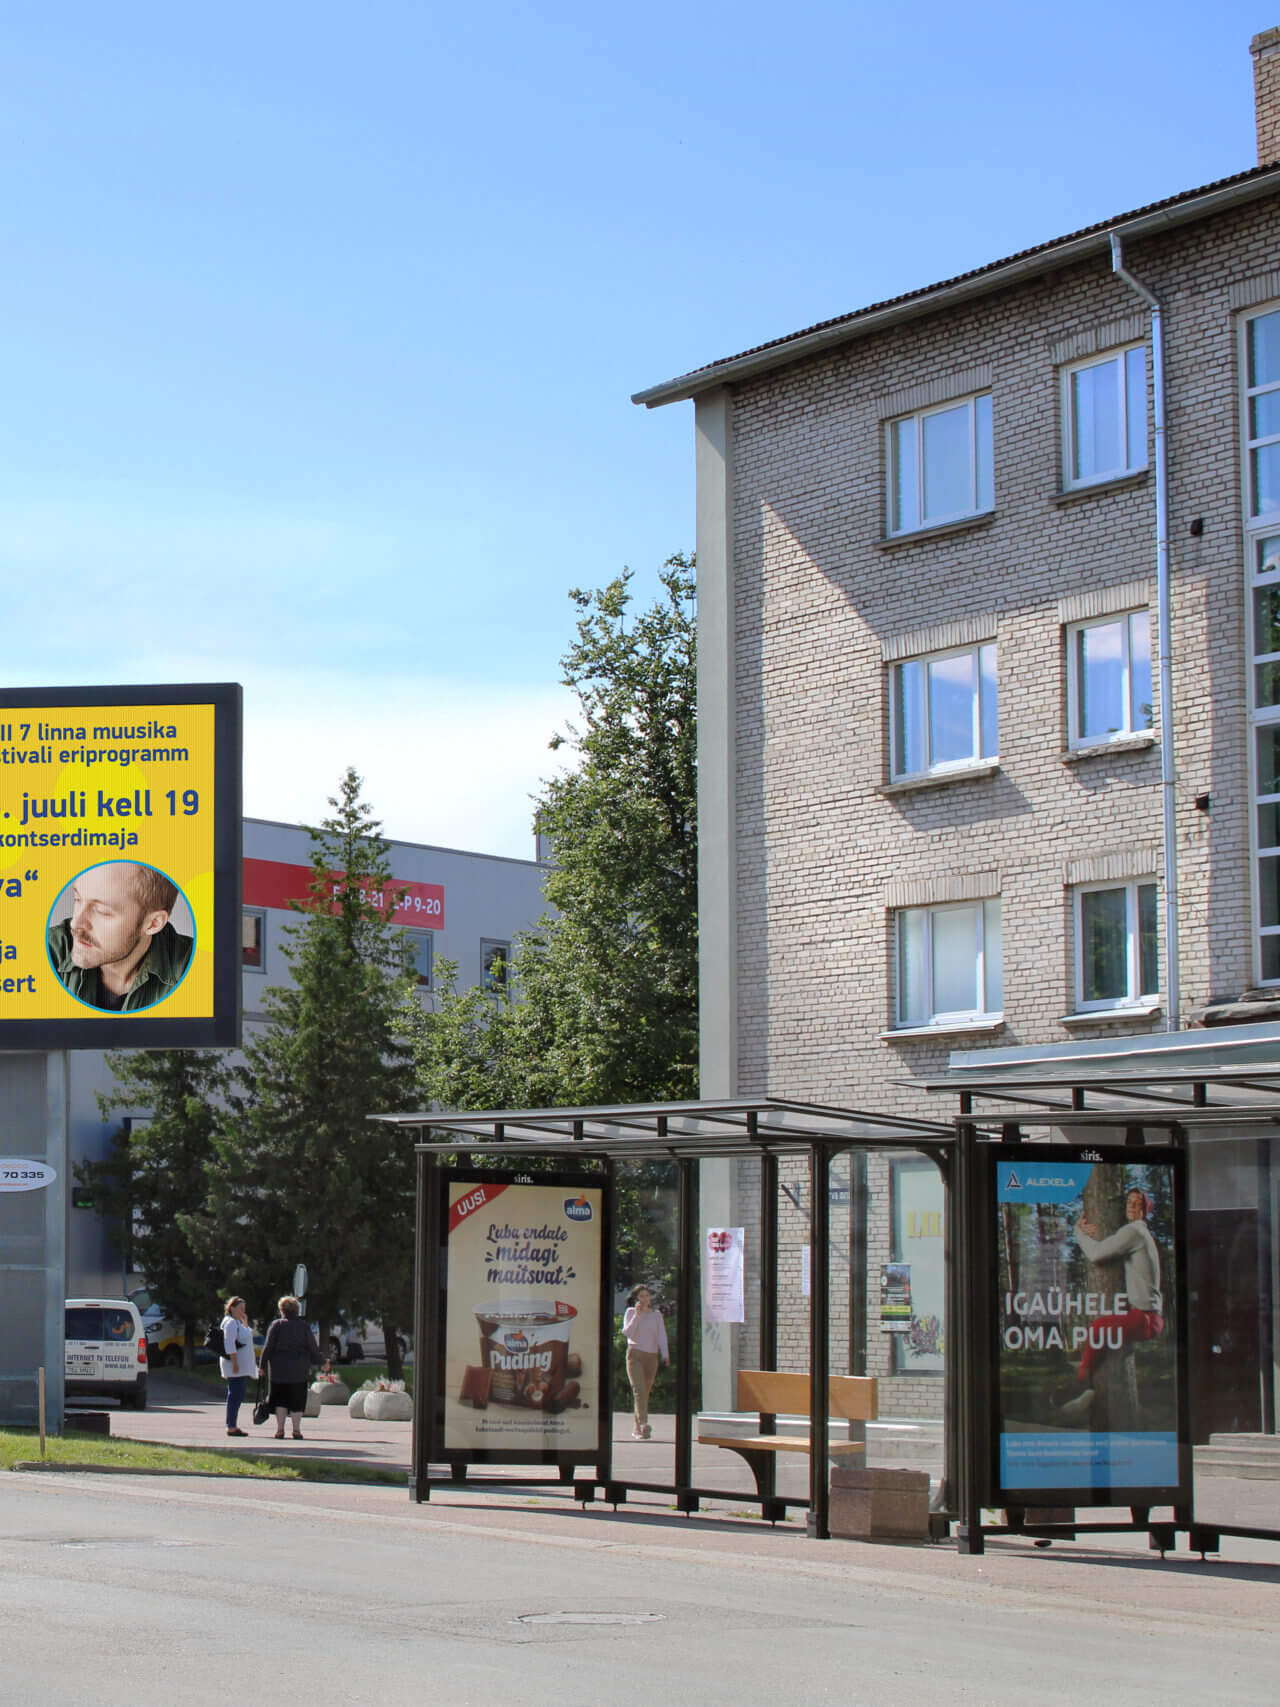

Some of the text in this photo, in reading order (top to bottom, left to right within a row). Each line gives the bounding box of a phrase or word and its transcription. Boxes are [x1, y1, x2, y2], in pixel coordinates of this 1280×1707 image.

[20, 724, 31, 741] 7
[38, 723, 86, 740] linna
[93, 721, 177, 740] muusika
[59, 745, 189, 767] eriprogramm
[20, 790, 86, 825] juuli
[97, 789, 152, 817] kell
[165, 789, 199, 816] 19
[414, 897, 441, 915] 9-20
[2, 1171, 19, 1179] 70
[21, 1171, 45, 1179] 335
[1026, 1177, 1075, 1187] ALEXELA
[457, 1188, 486, 1216] UUSI
[566, 1206, 592, 1216] alma
[486, 1223, 569, 1243] Luba endale
[496, 1241, 559, 1267] midagi
[1005, 1287, 1129, 1316] IGAÜHELE
[1005, 1326, 1123, 1350] OMA PUU
[489, 1350, 552, 1372] Puding
